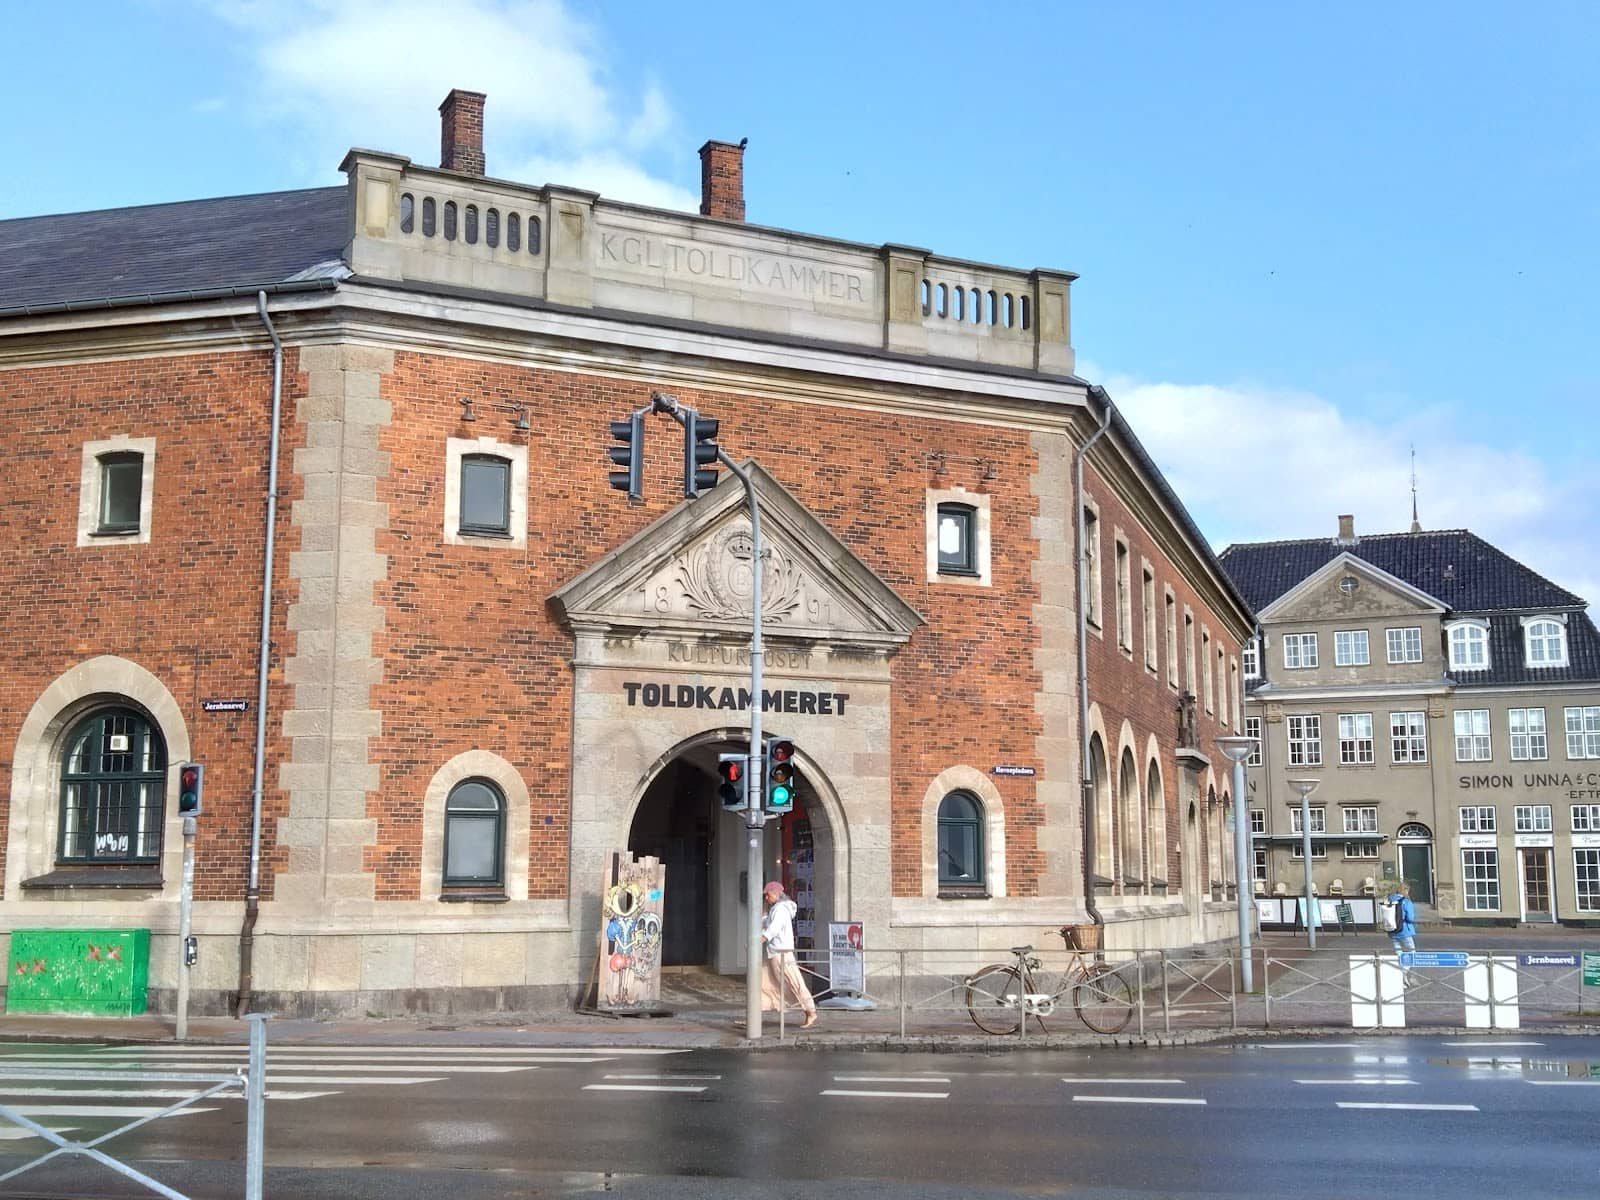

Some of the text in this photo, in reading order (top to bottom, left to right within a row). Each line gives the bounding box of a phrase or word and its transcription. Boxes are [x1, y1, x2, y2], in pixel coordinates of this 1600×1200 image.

[666, 243, 864, 302] TOLDKAMMER
[640, 585, 836, 626] 18 91
[667, 641, 814, 669] KULTURUSET
[622, 682, 850, 715] TOLDKAMMERET
[1459, 775, 1513, 789] SIMON
[1524, 773, 1573, 787] UNNA
